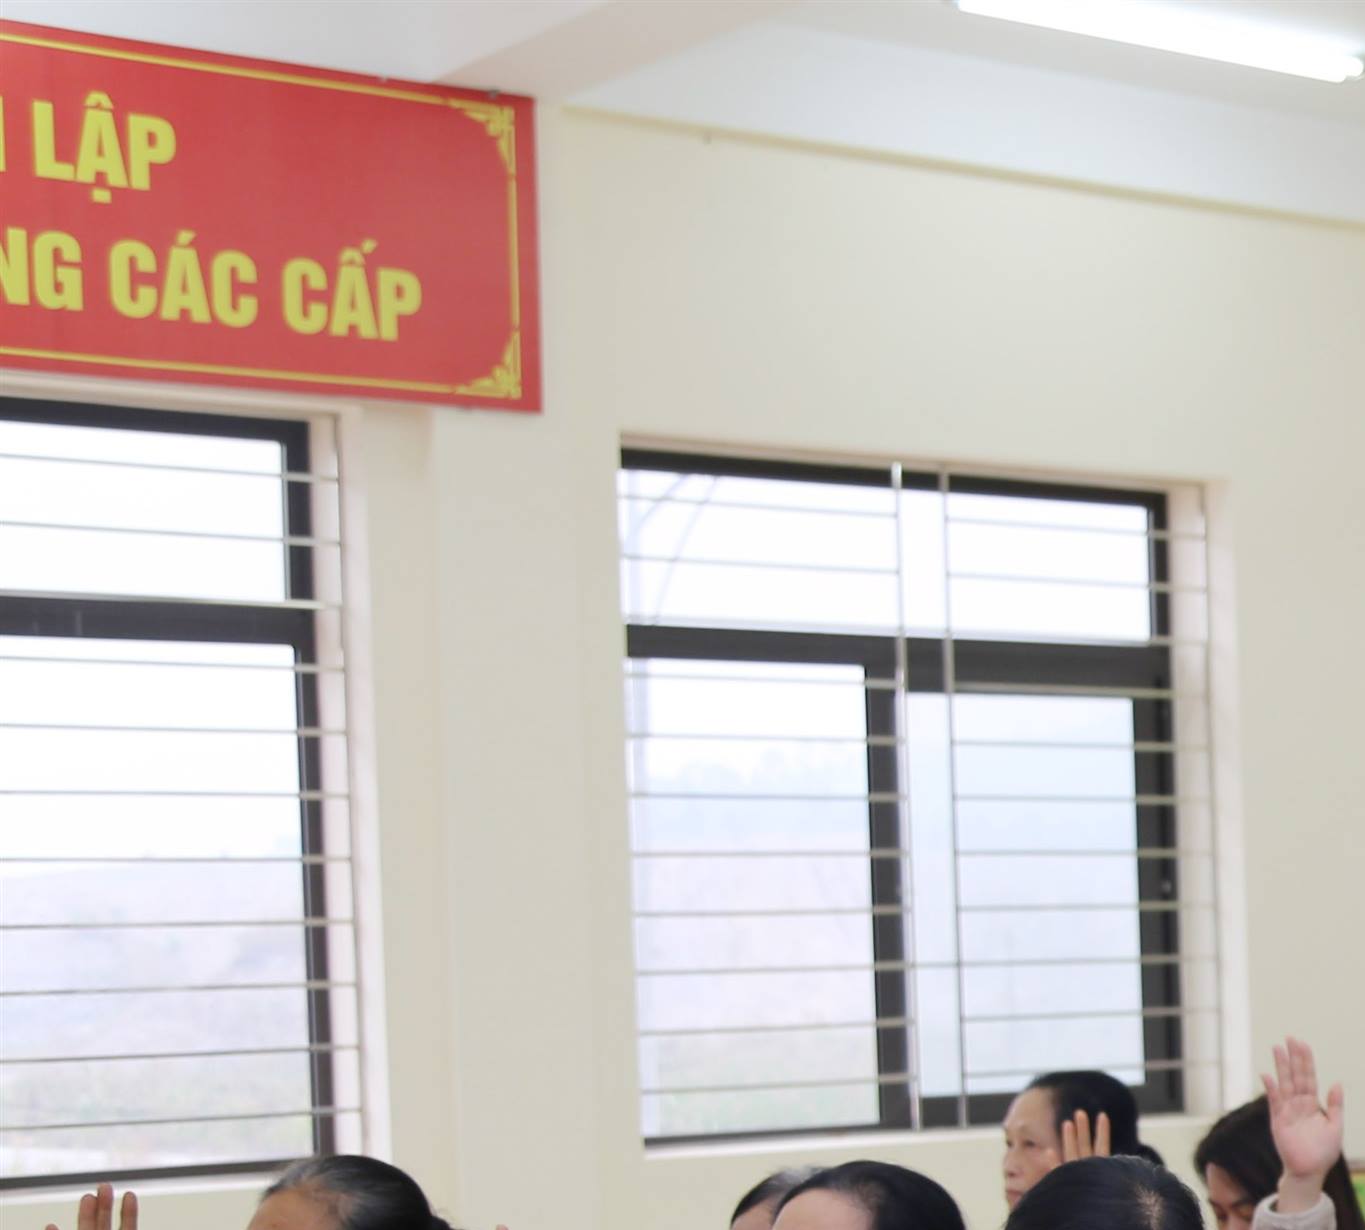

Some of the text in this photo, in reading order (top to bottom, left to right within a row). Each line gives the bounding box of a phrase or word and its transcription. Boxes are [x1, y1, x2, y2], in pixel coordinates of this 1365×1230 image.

[32, 91, 176, 203] LẬP
[109, 229, 258, 327] CÁC
[282, 240, 421, 340] CẤP
